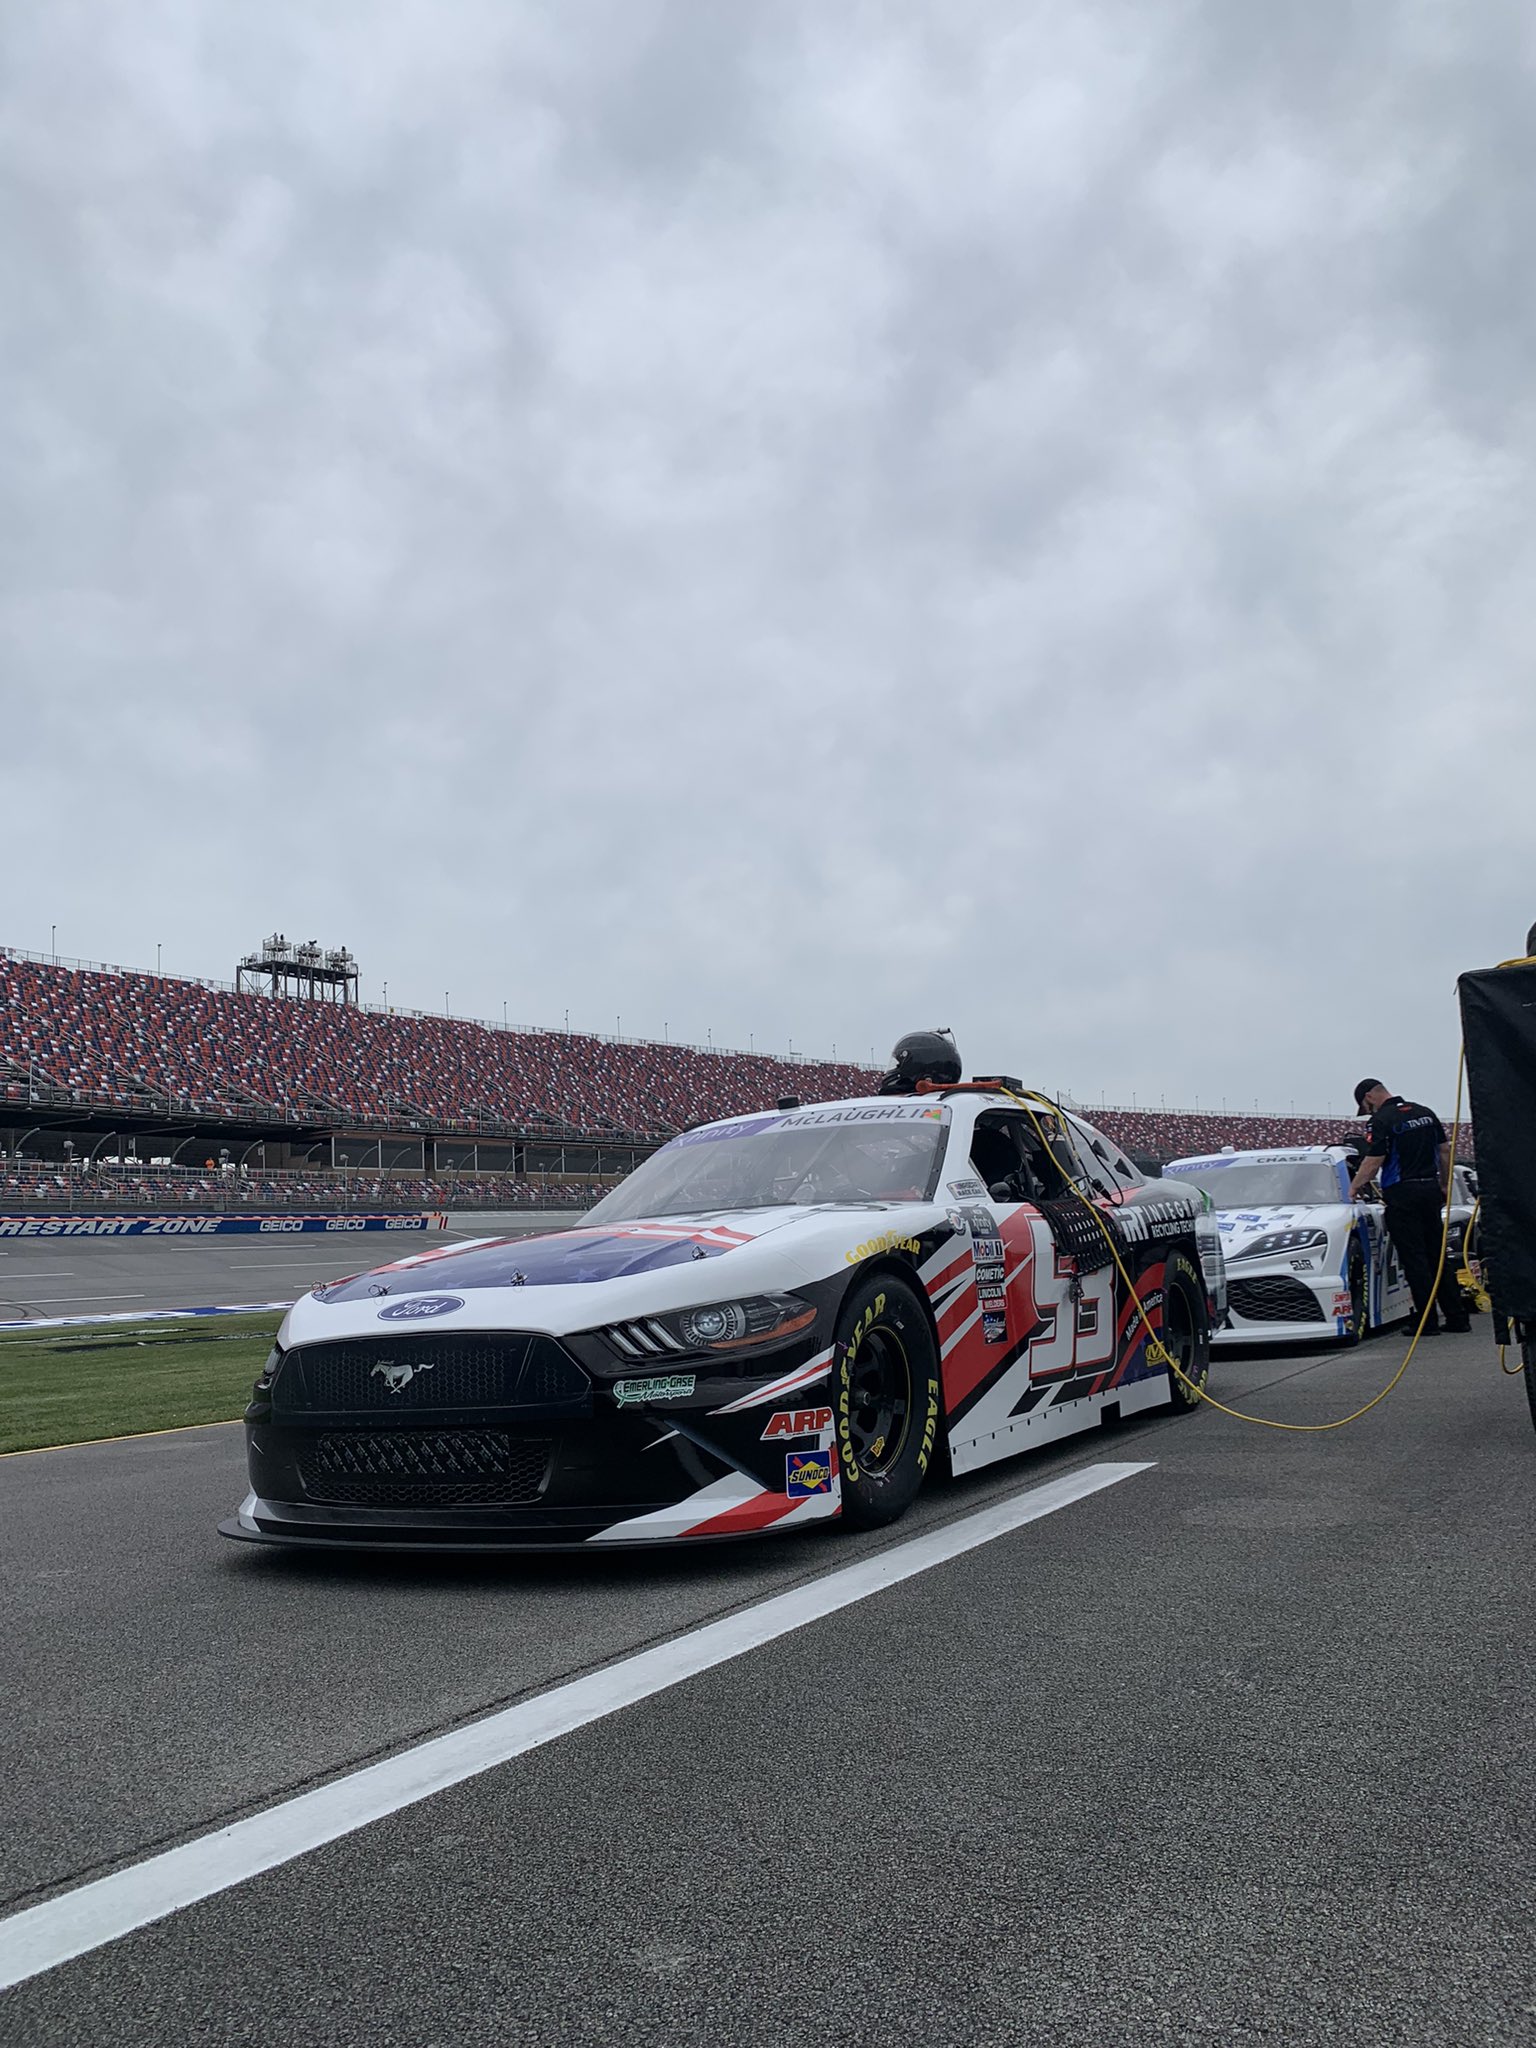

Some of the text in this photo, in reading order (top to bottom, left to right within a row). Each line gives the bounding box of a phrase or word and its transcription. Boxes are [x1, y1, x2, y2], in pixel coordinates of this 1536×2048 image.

[1257, 1156, 1308, 1164] CHASE
[0, 1219, 221, 1236] RESTART ZONE
[259, 1219, 304, 1232] GEICO
[325, 1218, 366, 1231] GEICO
[384, 1218, 423, 1230] GEICO
[845, 1229, 921, 1264] GOODYEAR
[973, 1241, 995, 1257] Mobil
[976, 1265, 1005, 1281] COMETIC
[391, 1299, 448, 1317] Ford
[765, 1408, 833, 1436] ARP
[917, 1378, 939, 1476] EAGLE
[791, 1467, 830, 1483] SUNOCO
